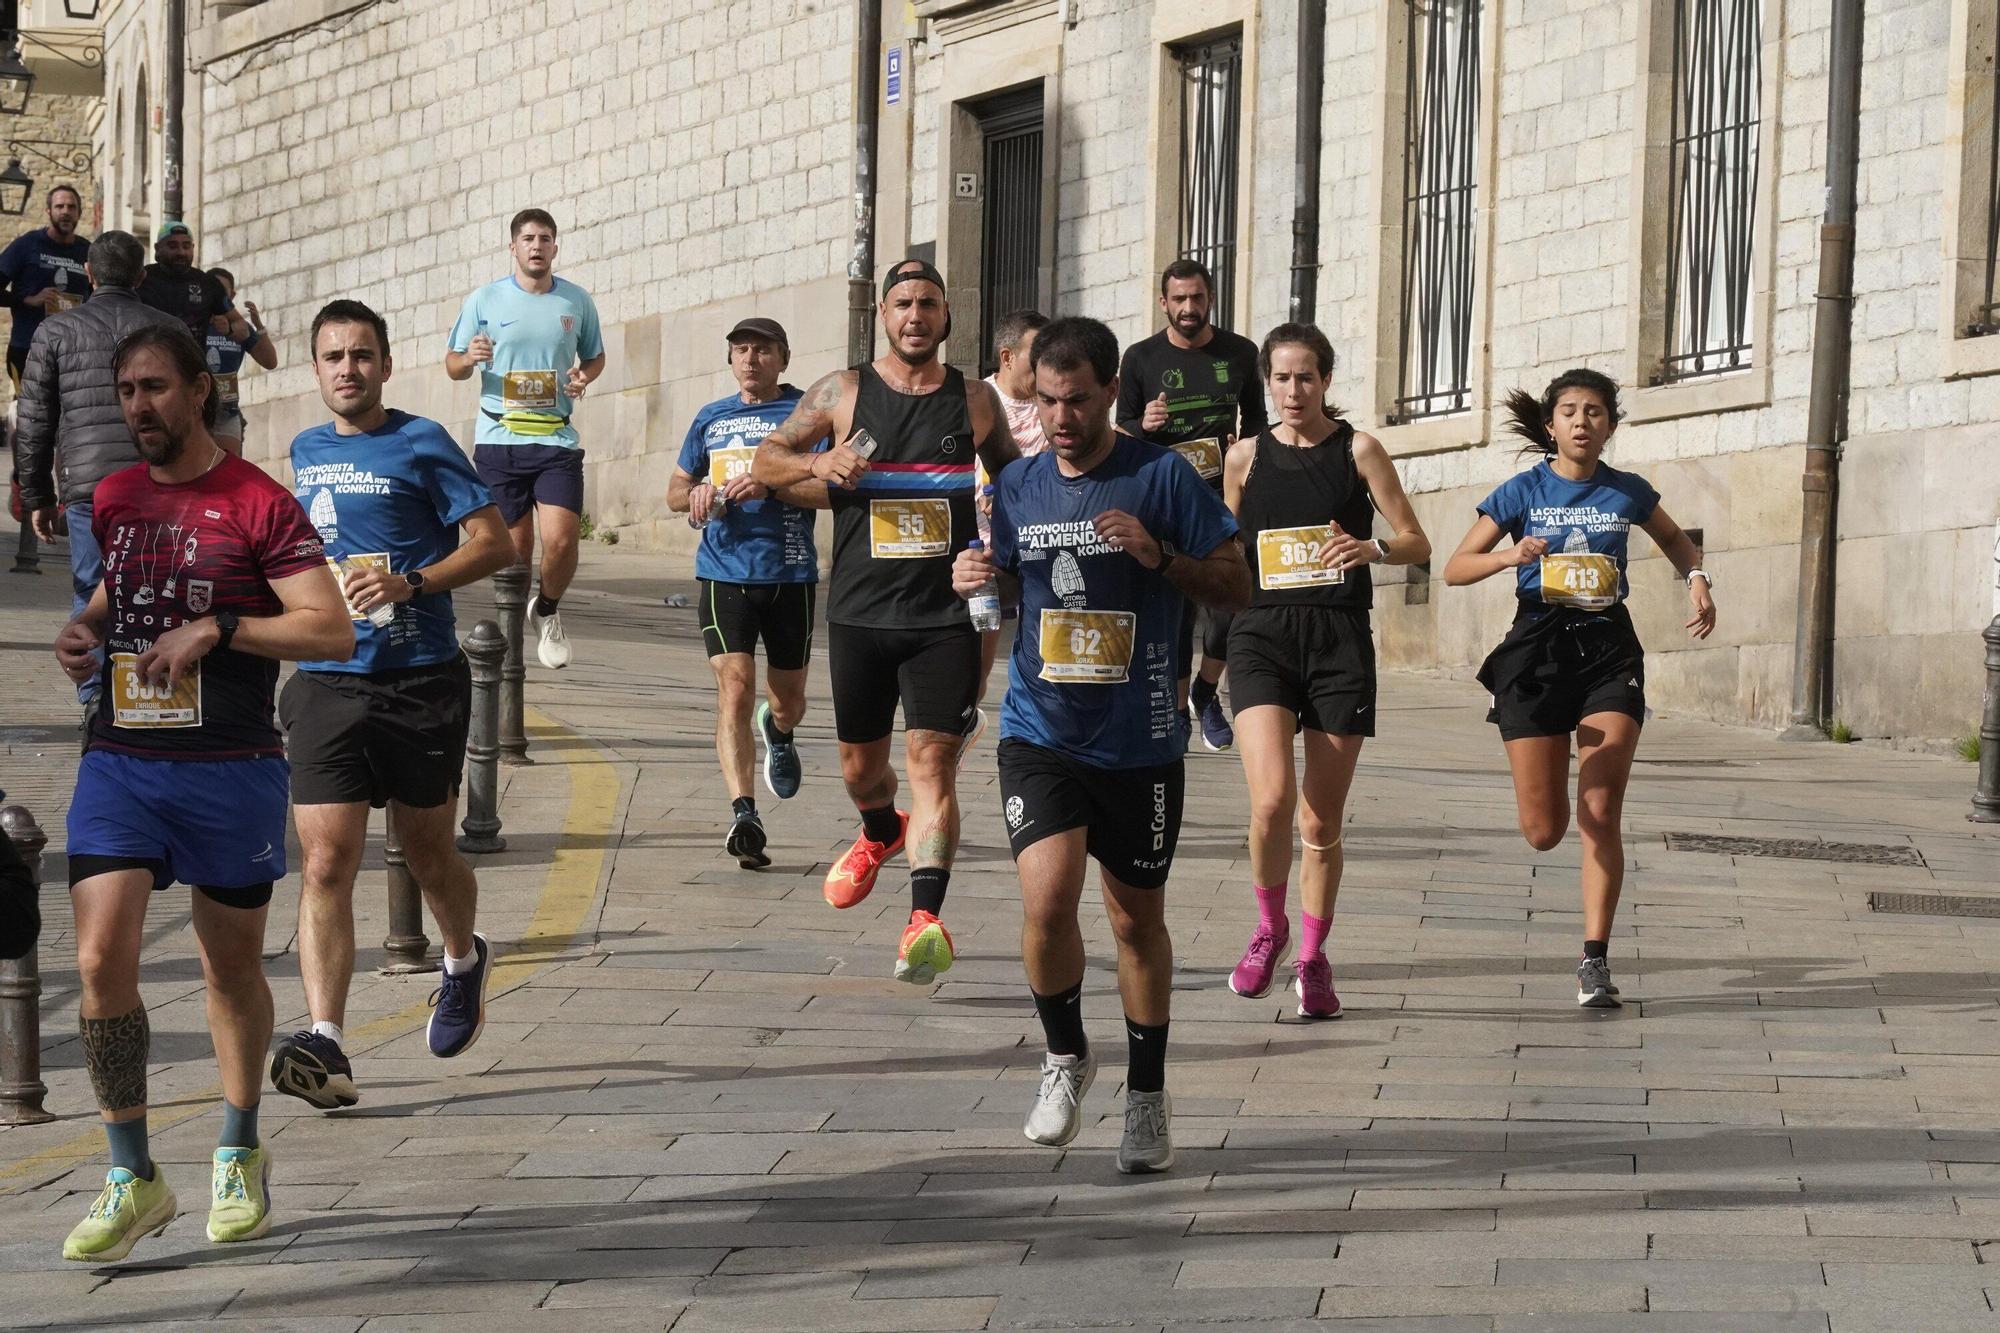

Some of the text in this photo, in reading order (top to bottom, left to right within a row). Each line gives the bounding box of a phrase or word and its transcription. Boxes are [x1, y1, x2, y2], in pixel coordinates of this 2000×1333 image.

[517, 380, 544, 395] 329
[714, 422, 777, 437] ALMENDRA
[715, 416, 761, 428] CONQUISTA
[1182, 450, 1207, 465] 52
[304, 463, 355, 476] CONQUISTA
[301, 471, 374, 487] ALMENDRA
[334, 483, 391, 495] KONKISTA
[1530, 506, 1599, 516] LA CONQUISTA
[898, 514, 925, 536] 55
[1545, 512, 1620, 527] ALMENDRA
[1018, 520, 1095, 535] LA CONQUISTA
[1586, 523, 1629, 533] KONKISTA
[1018, 535, 1025, 543] DE
[1029, 530, 1118, 549] ALMEND
[1279, 541, 1321, 566] 362
[1564, 568, 1599, 589] 413
[1116, 618, 1129, 627] 10K
[1070, 628, 1101, 655] 62
